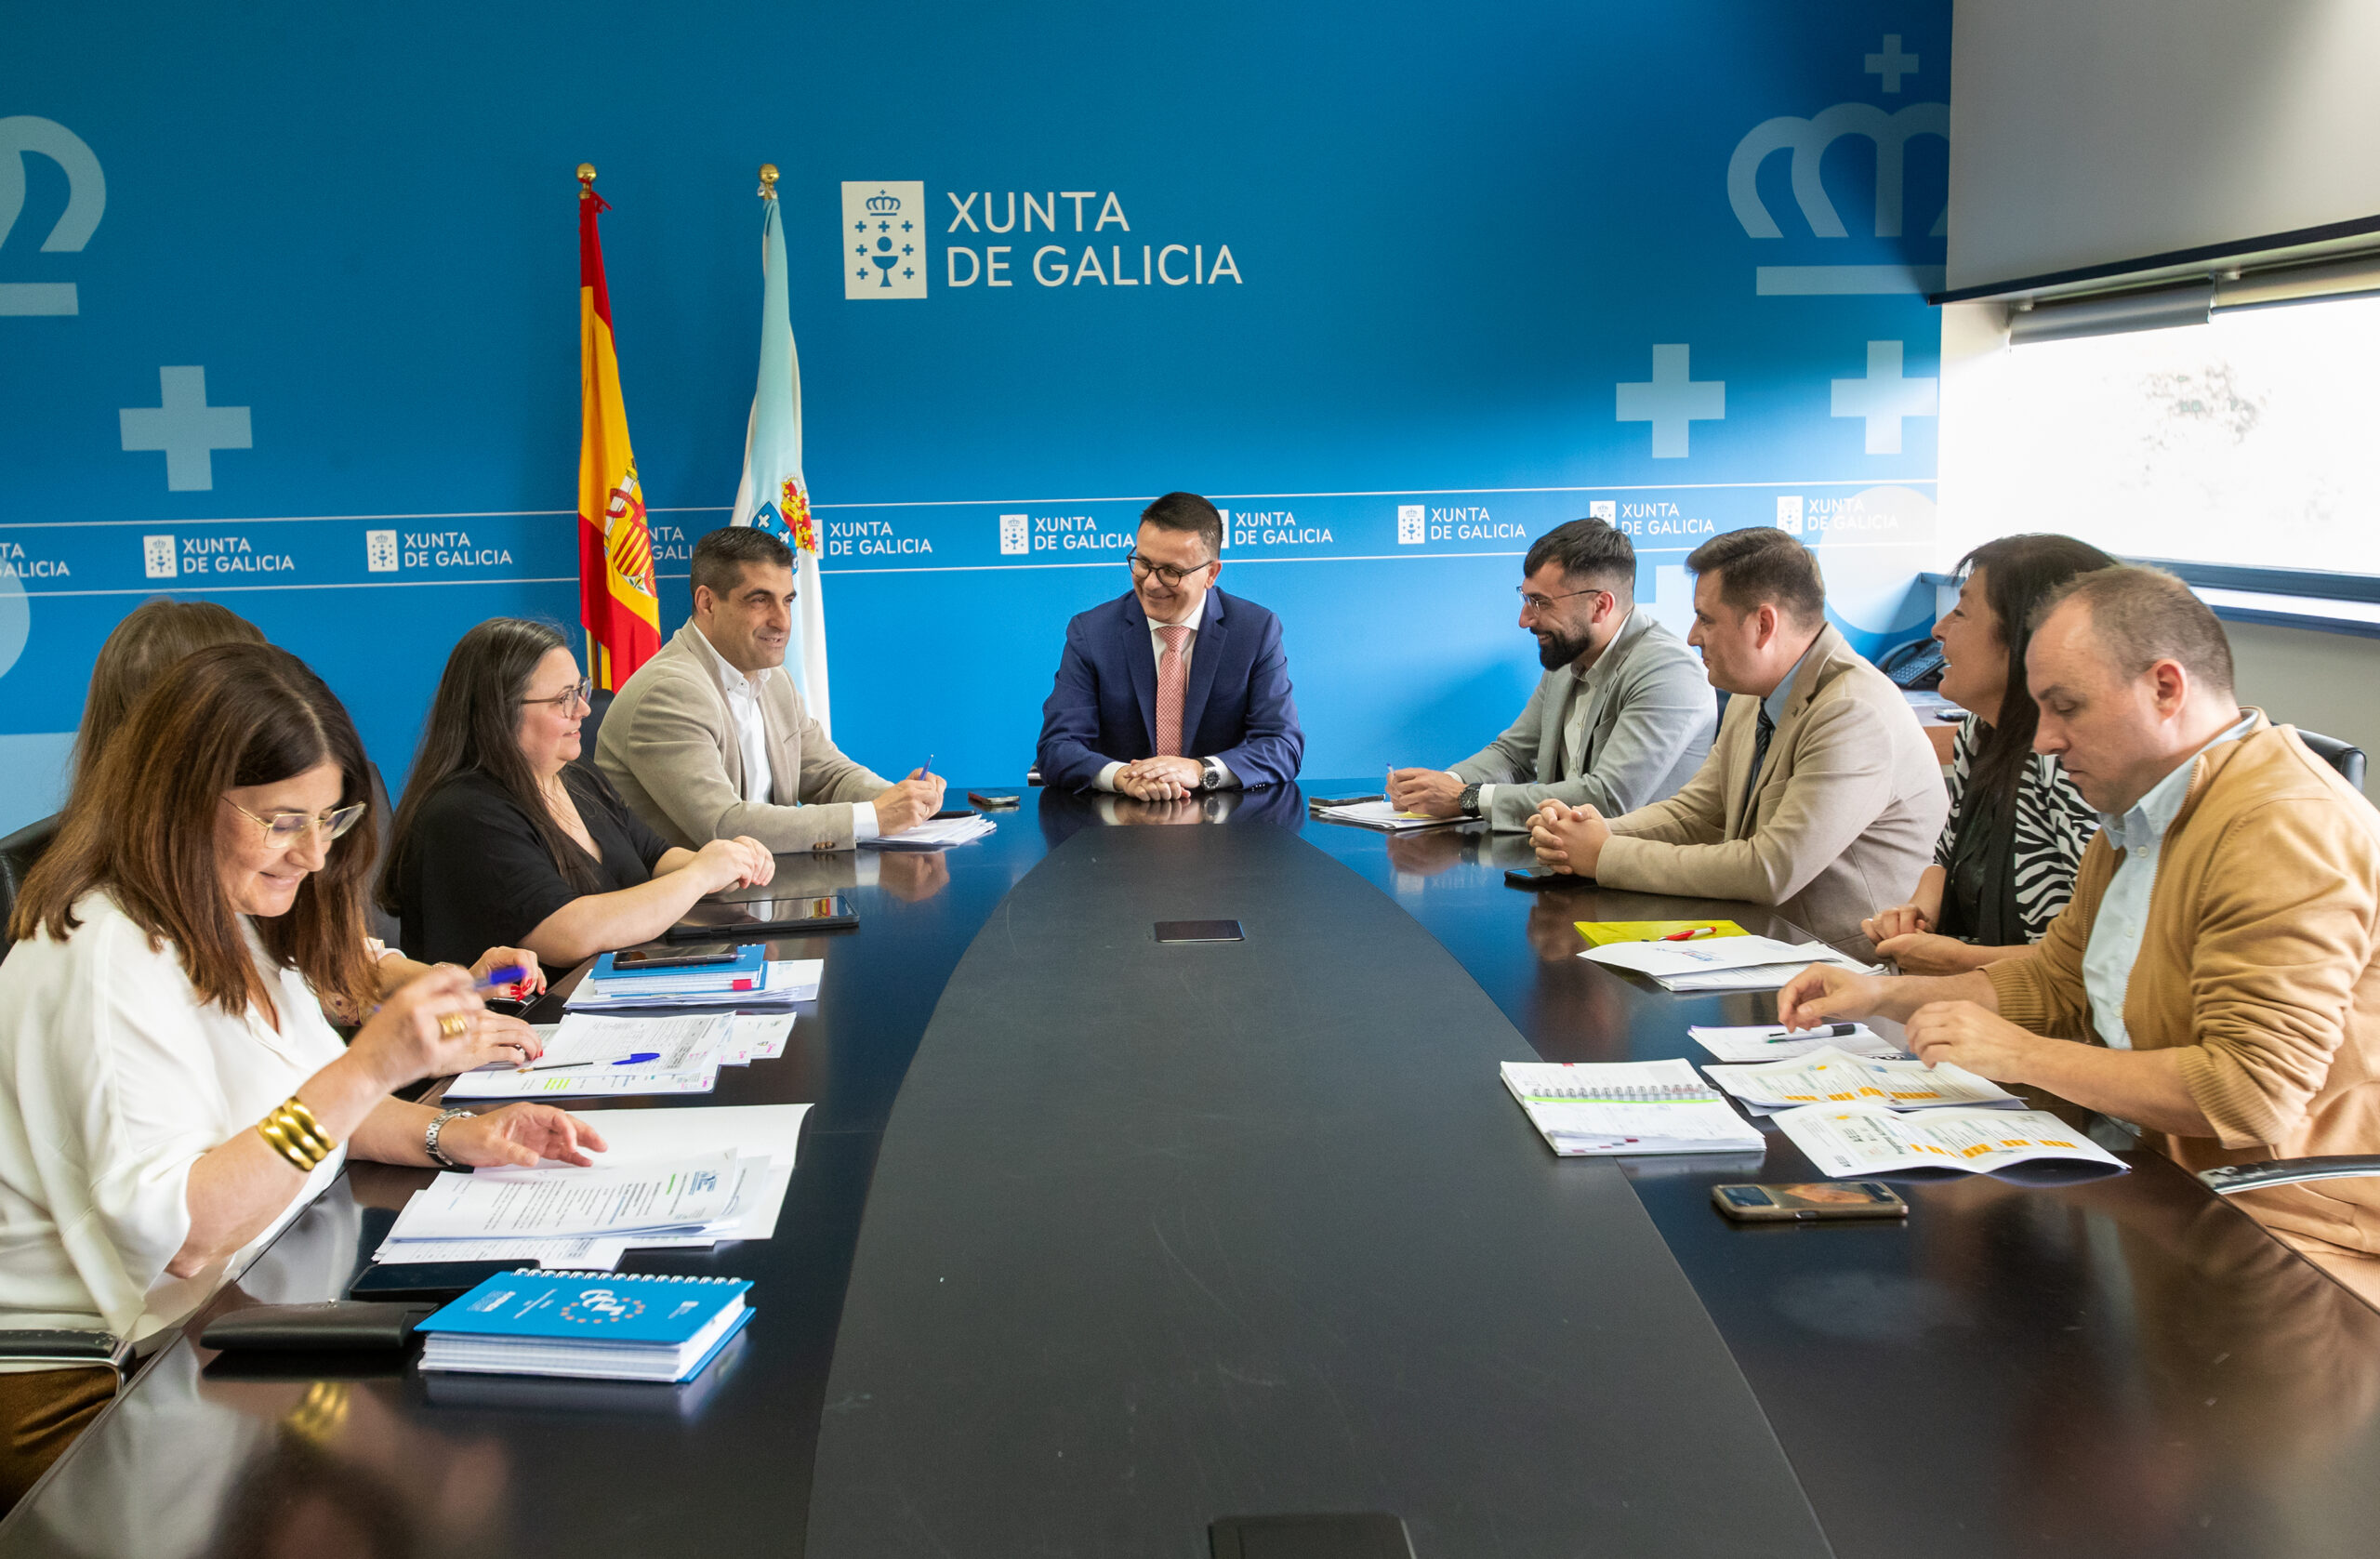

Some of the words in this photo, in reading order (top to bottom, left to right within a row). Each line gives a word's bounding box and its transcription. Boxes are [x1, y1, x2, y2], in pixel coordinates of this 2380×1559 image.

[946, 192, 1130, 233] XUNTA
[946, 246, 1013, 287] DE
[1032, 244, 1243, 287] GALICIA
[1431, 507, 1491, 523] XUNTA
[1621, 503, 1681, 519] XUNTA
[1808, 498, 1867, 514] XUNTA
[1034, 517, 1098, 533] XUNTA
[1235, 511, 1297, 528] XUNTA
[1621, 521, 1644, 536] DE
[1647, 519, 1715, 535] GALICIA
[1807, 515, 1830, 532] DE
[1832, 514, 1898, 530] GALICIA
[829, 522, 893, 537] XUNTA
[1235, 530, 1258, 546] DE
[1263, 528, 1334, 545] GALICIA
[1430, 524, 1453, 541] DE
[1458, 522, 1527, 540] GALICIA
[183, 536, 252, 555] XUNTA
[403, 532, 471, 549] XUNTA
[829, 539, 853, 556] DE
[858, 538, 933, 556] GALICIA
[1034, 535, 1058, 551] DE
[1063, 533, 1135, 549] GALICIA
[183, 559, 209, 574] DE
[215, 555, 296, 574] GALICIA
[403, 552, 430, 568] DE
[435, 549, 513, 567] GALICIA
[0, 560, 71, 578] ALICIA
